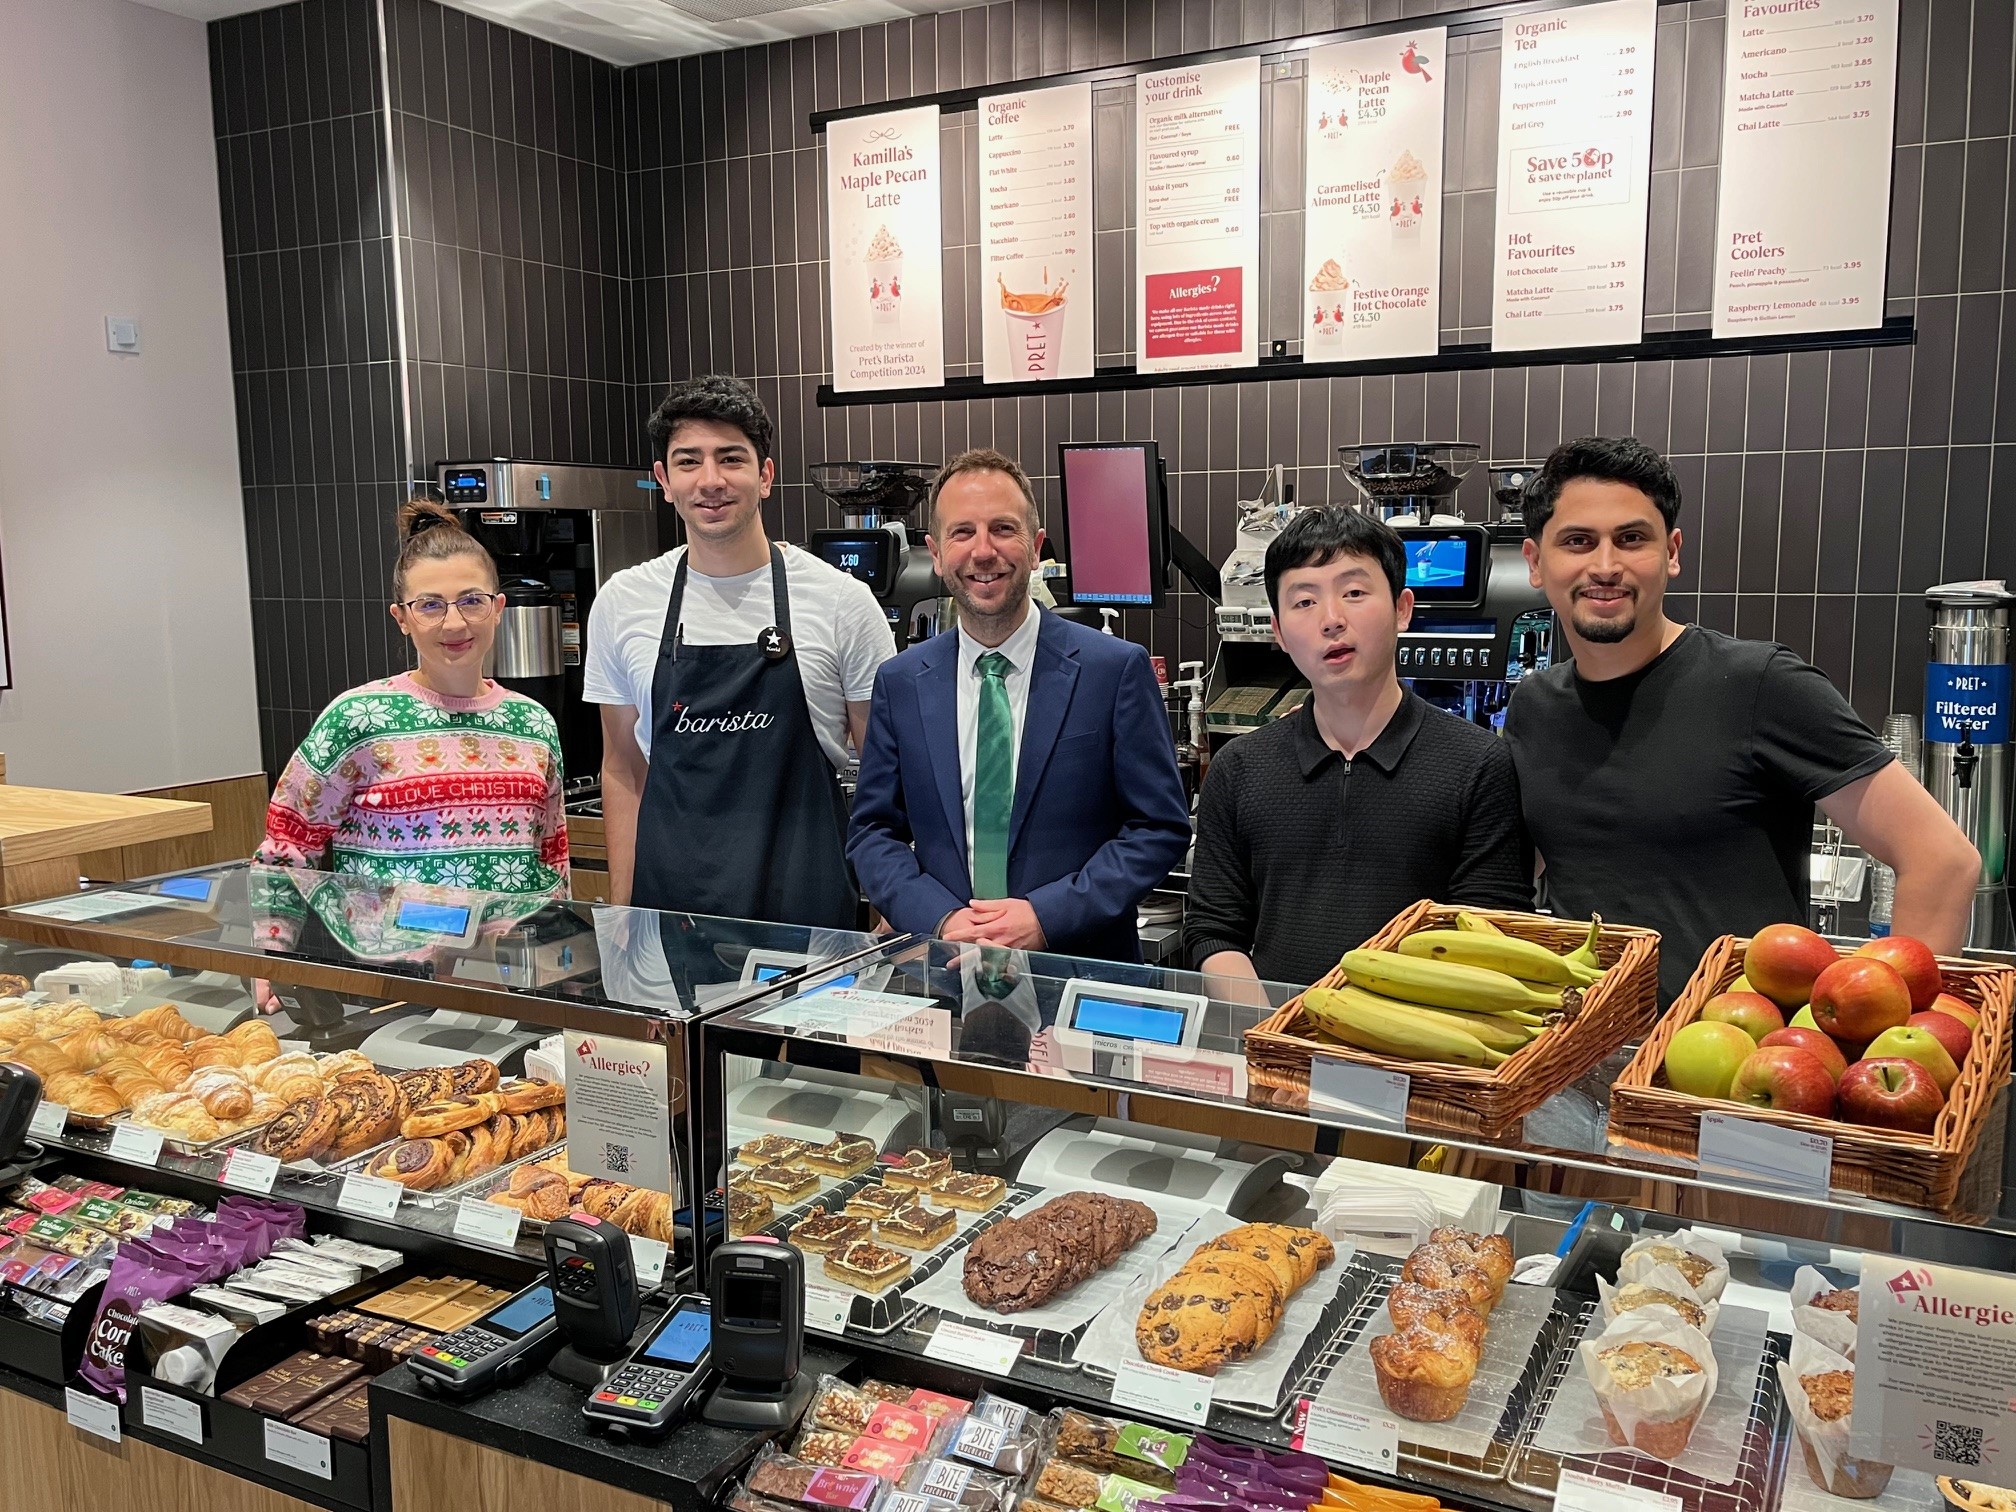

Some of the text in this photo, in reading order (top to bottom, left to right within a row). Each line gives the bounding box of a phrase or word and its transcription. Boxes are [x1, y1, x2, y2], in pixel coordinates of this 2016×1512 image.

[1743, 0, 1820, 18] Favourites
[1515, 18, 1568, 37] Organic
[1742, 14, 1874, 38] Latte 3.70
[1515, 39, 1537, 51] Tea
[1619, 46, 1635, 55] 2.90
[1741, 36, 1873, 59] Americano 3.20
[1618, 68, 1635, 76] 2.90
[1740, 58, 1872, 80] Mocha 3.85
[1145, 72, 1201, 89] Customise
[1359, 71, 1391, 85] Maple
[1145, 84, 1203, 105] your drink
[1358, 85, 1389, 97] Pecan
[1739, 80, 1871, 102] Matcha Latte 3.75
[988, 98, 1027, 114] Organic
[1358, 98, 1386, 109] Latte
[1512, 89, 1633, 111] Peppermint 2.90
[988, 113, 1020, 126] Coffee
[1149, 109, 1223, 125] Organic milk alternative
[1511, 121, 1527, 131] Earl
[1616, 110, 1632, 118] 2.90
[1737, 110, 1870, 132] Chai Latte 3.75
[853, 145, 913, 167] Kamilla's
[988, 149, 1022, 159] Cappuccino
[1149, 150, 1179, 161] Flavoured
[1180, 149, 1199, 158] syrup
[1527, 156, 1567, 173] Save
[840, 168, 927, 191] Maple Pecan
[1528, 169, 1612, 184] & save the planet
[1149, 184, 1165, 192] Make
[1171, 182, 1189, 190] yours
[1317, 178, 1381, 195] Caramelised
[867, 193, 901, 209] Latte
[990, 202, 1019, 210] Americano
[1311, 192, 1380, 207] Almond Latte
[1149, 223, 1161, 231] Top
[1176, 219, 1199, 228] organic
[990, 237, 1018, 245] Macchiato
[1508, 232, 1532, 246] Hot
[1732, 230, 1763, 245] Pret
[1507, 244, 1575, 260] Favourites
[1731, 245, 1785, 260] Coolers
[1507, 261, 1626, 276] Hot Chocolate 3.75
[1730, 261, 1861, 278] Feelin' Peachy 3.95
[1169, 275, 1221, 300] Allergies?
[1353, 286, 1430, 300] Festive Orange
[1506, 281, 1625, 296] Matcha Latte 3.75
[1353, 297, 1427, 312] Hot Chocolate
[1728, 297, 1860, 314] Raspberry Lemonade 3.95
[1505, 310, 1522, 319] Chai
[1523, 309, 1542, 317] Latte
[850, 340, 925, 352] Created by the winner of
[1026, 334, 1046, 371] PRET
[859, 353, 914, 366] Pret's Barista
[850, 365, 926, 380] Competition 2024
[1955, 676, 1980, 691] PRET
[1936, 701, 1997, 716] Filtered
[674, 706, 775, 733] barista
[384, 792, 391, 806] I
[394, 784, 444, 804] LOVE
[1094, 1040, 1118, 1048] micros
[589, 1056, 651, 1077] Allergies?
[1705, 1115, 1724, 1124] Apple
[1912, 1295, 2016, 1327] Allergie
[1311, 1404, 1370, 1423] Pret's Cinnamon Crown
[1294, 1411, 1307, 1436] New
[971, 1425, 1001, 1450] BITE
[936, 1465, 966, 1491] BITE
